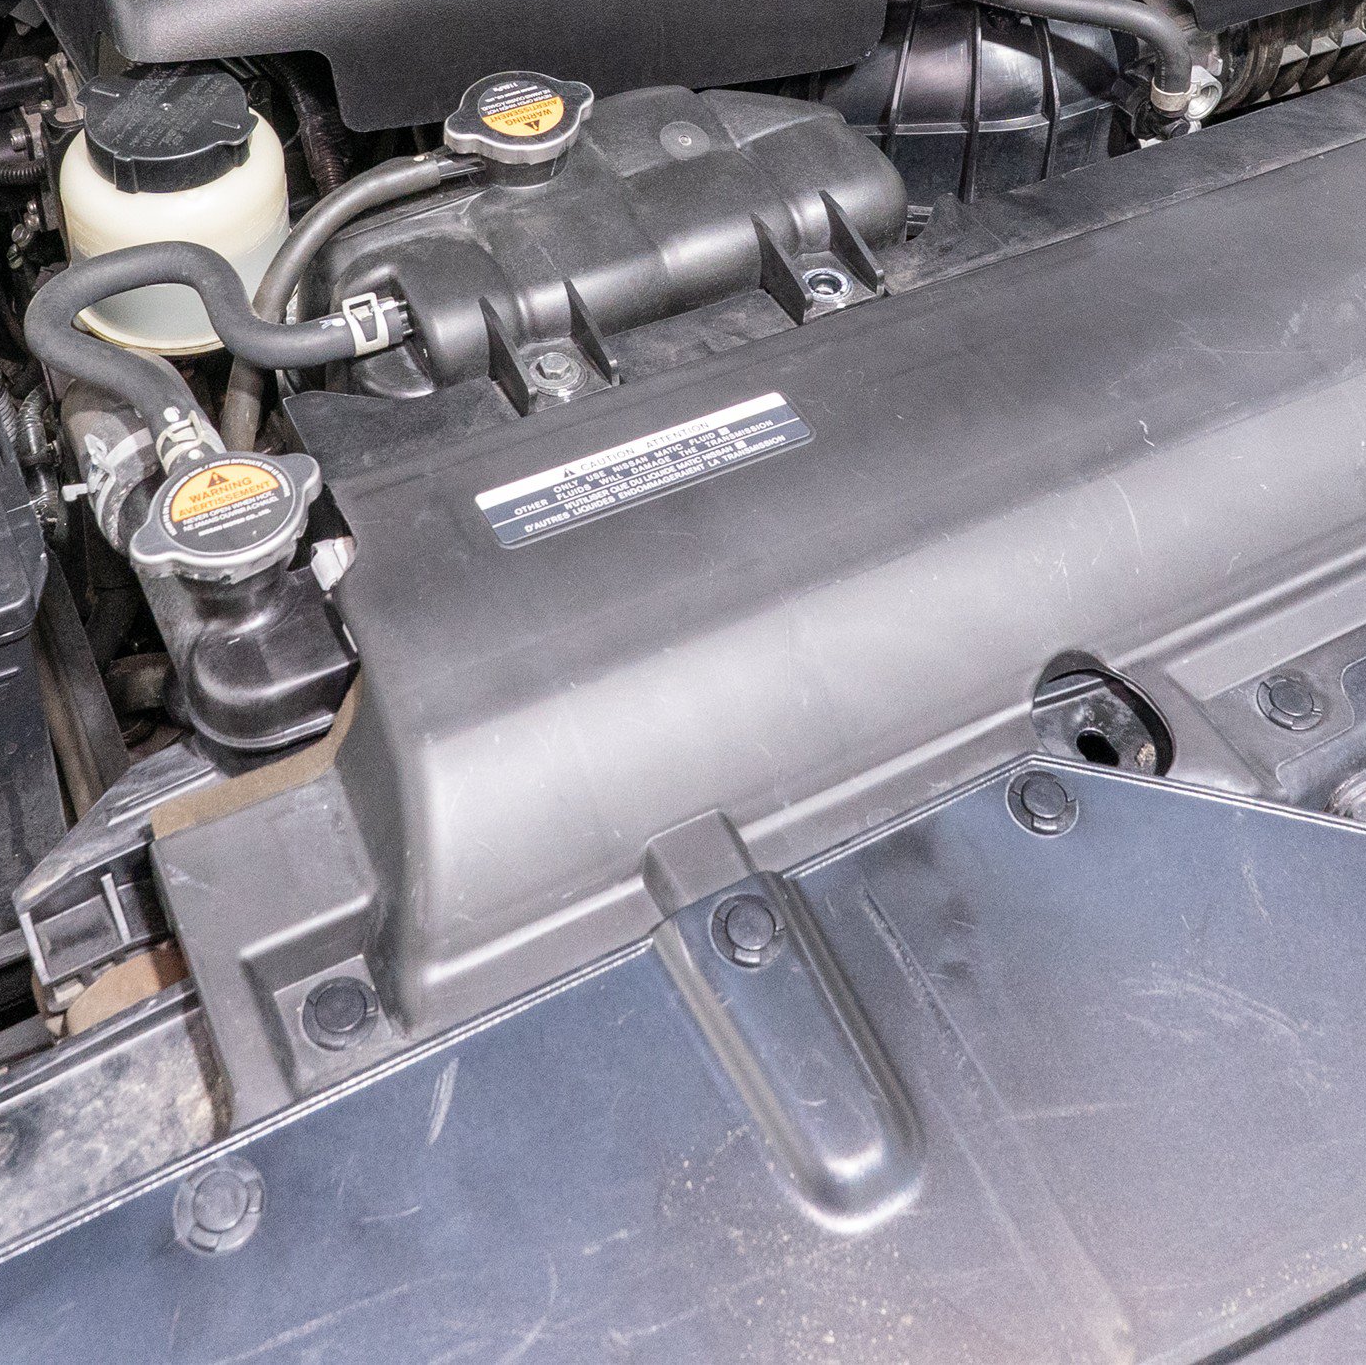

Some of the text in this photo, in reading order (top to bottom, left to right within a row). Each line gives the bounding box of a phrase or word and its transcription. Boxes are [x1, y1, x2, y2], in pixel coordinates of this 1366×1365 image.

[490, 99, 557, 123] AVERTISSEMENT
[505, 109, 553, 126] WARNING
[553, 432, 716, 493] ONLY USE NISSAN MATIC FLUID
[580, 447, 635, 471] CAUTION
[646, 421, 710, 448] ATTENTION
[514, 499, 549, 516] OTHER
[555, 483, 592, 501] FLUIDS
[599, 474, 624, 485] WILL
[630, 457, 672, 475] DAMAGE
[678, 446, 699, 457] THE
[704, 419, 774, 448] TRANSMISSION
[524, 511, 570, 533] D'AUTRES
[572, 496, 616, 516] LIQUIDES
[617, 464, 706, 500] ENDOMMAGERAIENT
[708, 458, 721, 467] LA
[721, 434, 786, 463] TRANSMISSION
[609, 482, 629, 494] QUE
[629, 477, 643, 487] DU
[644, 464, 678, 482] LIQUIDE
[677, 456, 702, 471] MATIC
[702, 446, 734, 461] NISSAN
[179, 481, 271, 517] AVERTISSEMENT
[189, 477, 252, 504] WARNING
[182, 512, 210, 526] NEVER
[209, 506, 232, 519] OPEN
